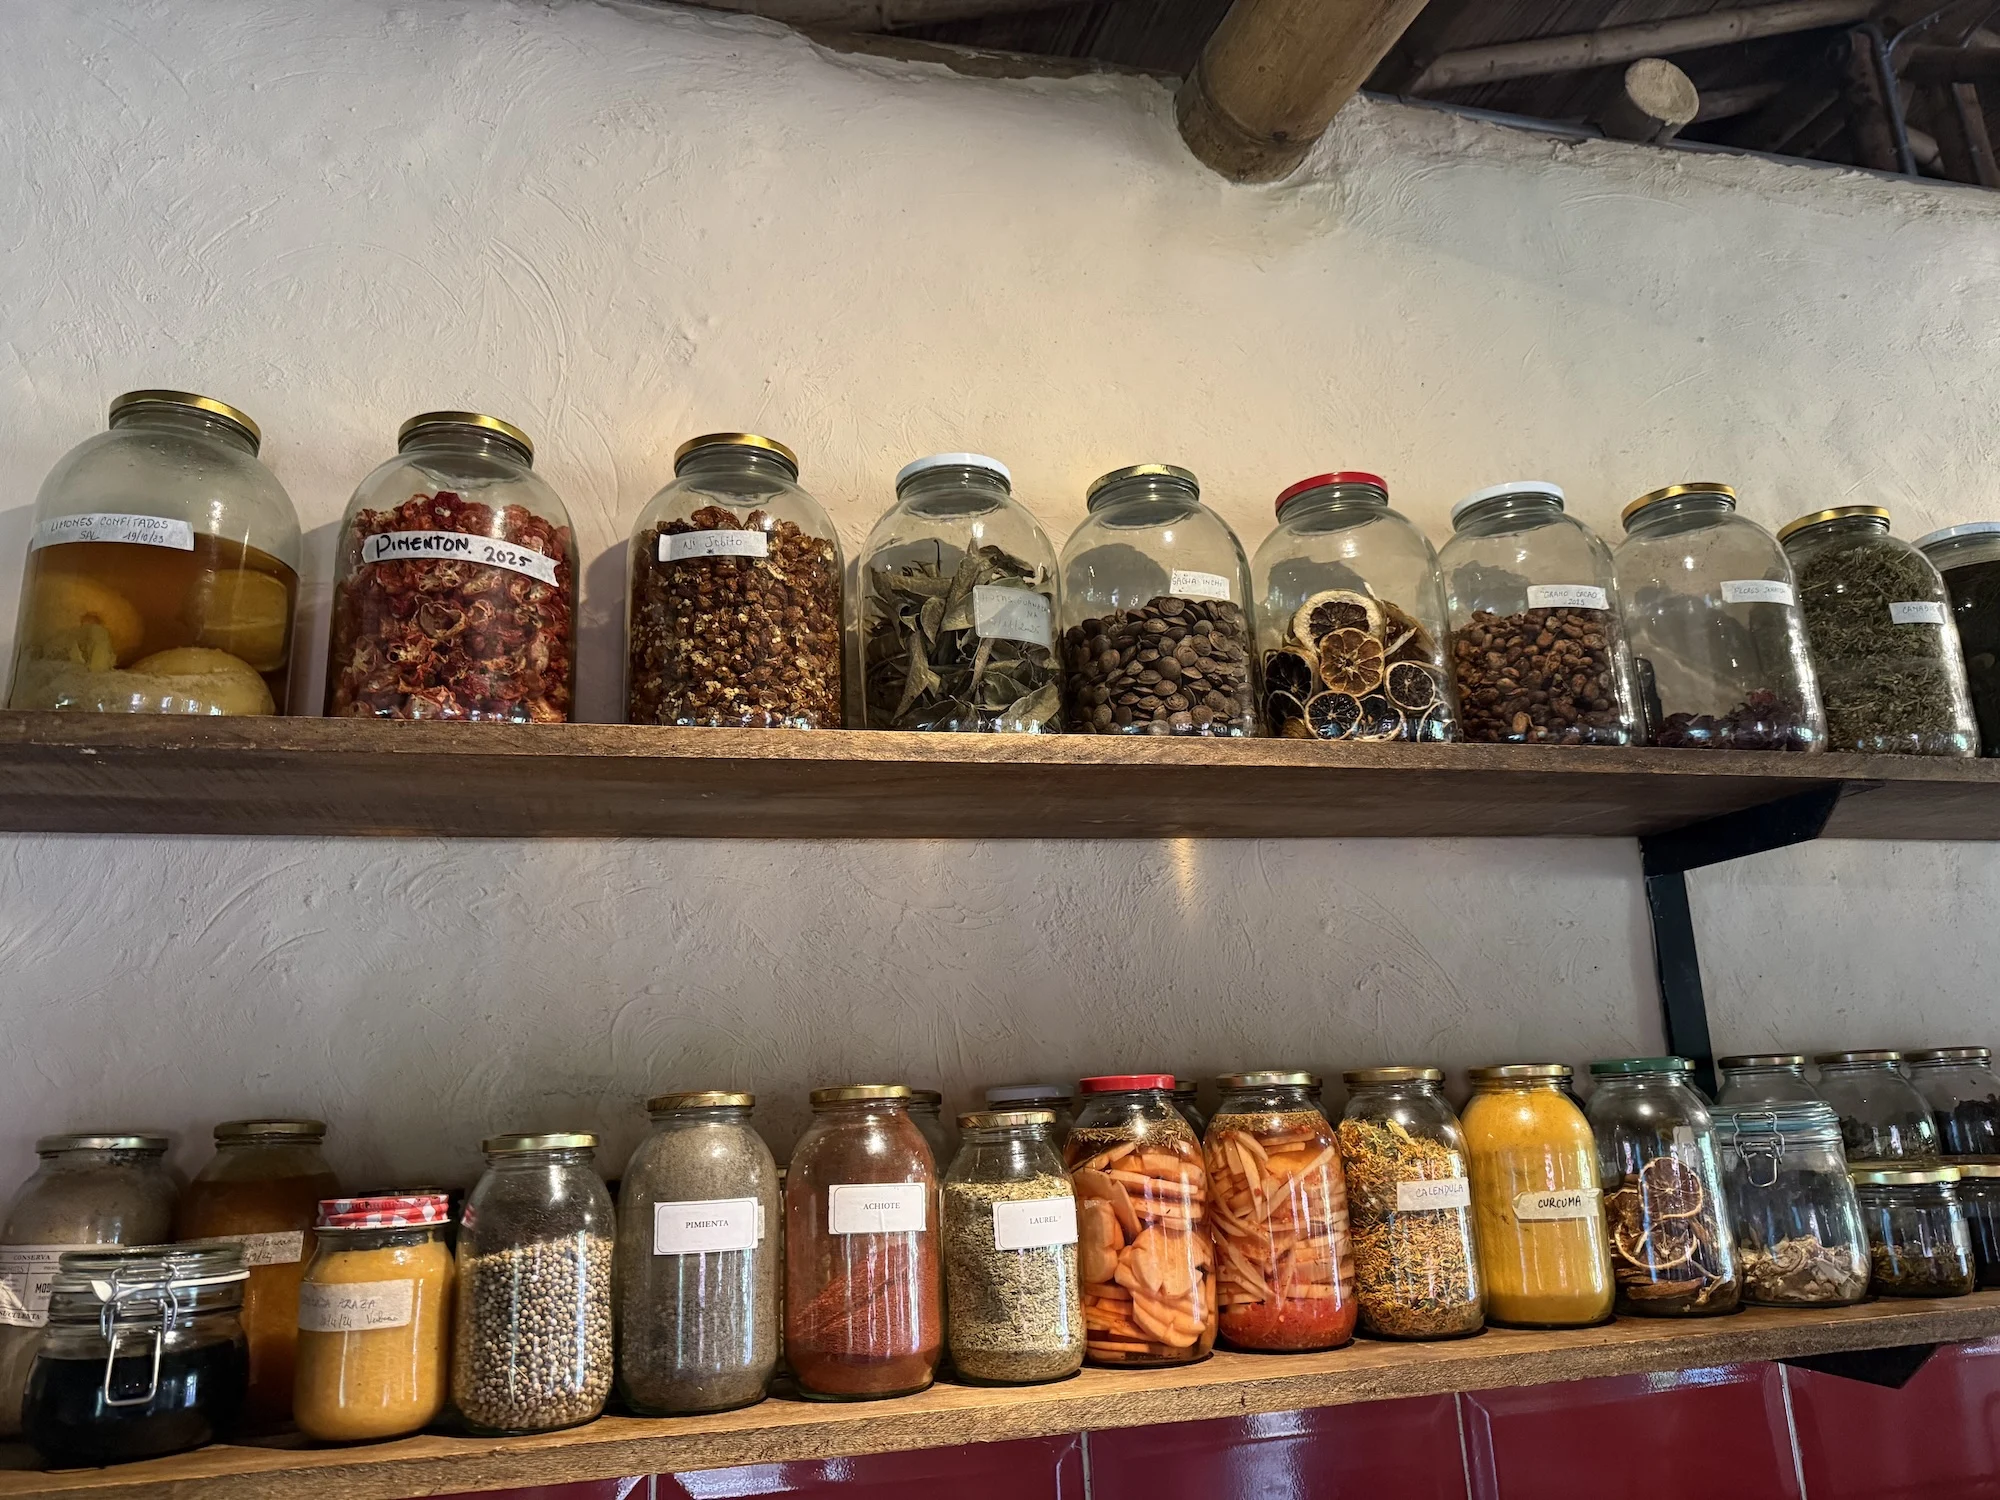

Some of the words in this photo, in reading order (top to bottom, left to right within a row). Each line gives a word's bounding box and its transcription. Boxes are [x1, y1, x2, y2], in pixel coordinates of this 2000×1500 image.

[50, 517, 94, 532] LIMONES
[99, 516, 169, 530] CONFITADOS
[483, 545, 533, 567] 2025
[1575, 590, 1598, 599] CACAO
[1415, 1183, 1465, 1198] CALENDULA
[862, 1201, 901, 1210] ACHIOTE
[1537, 1195, 1582, 1209] CURCUMA
[685, 1219, 729, 1229] PIMIENTA
[1029, 1215, 1059, 1225] LAUREL
